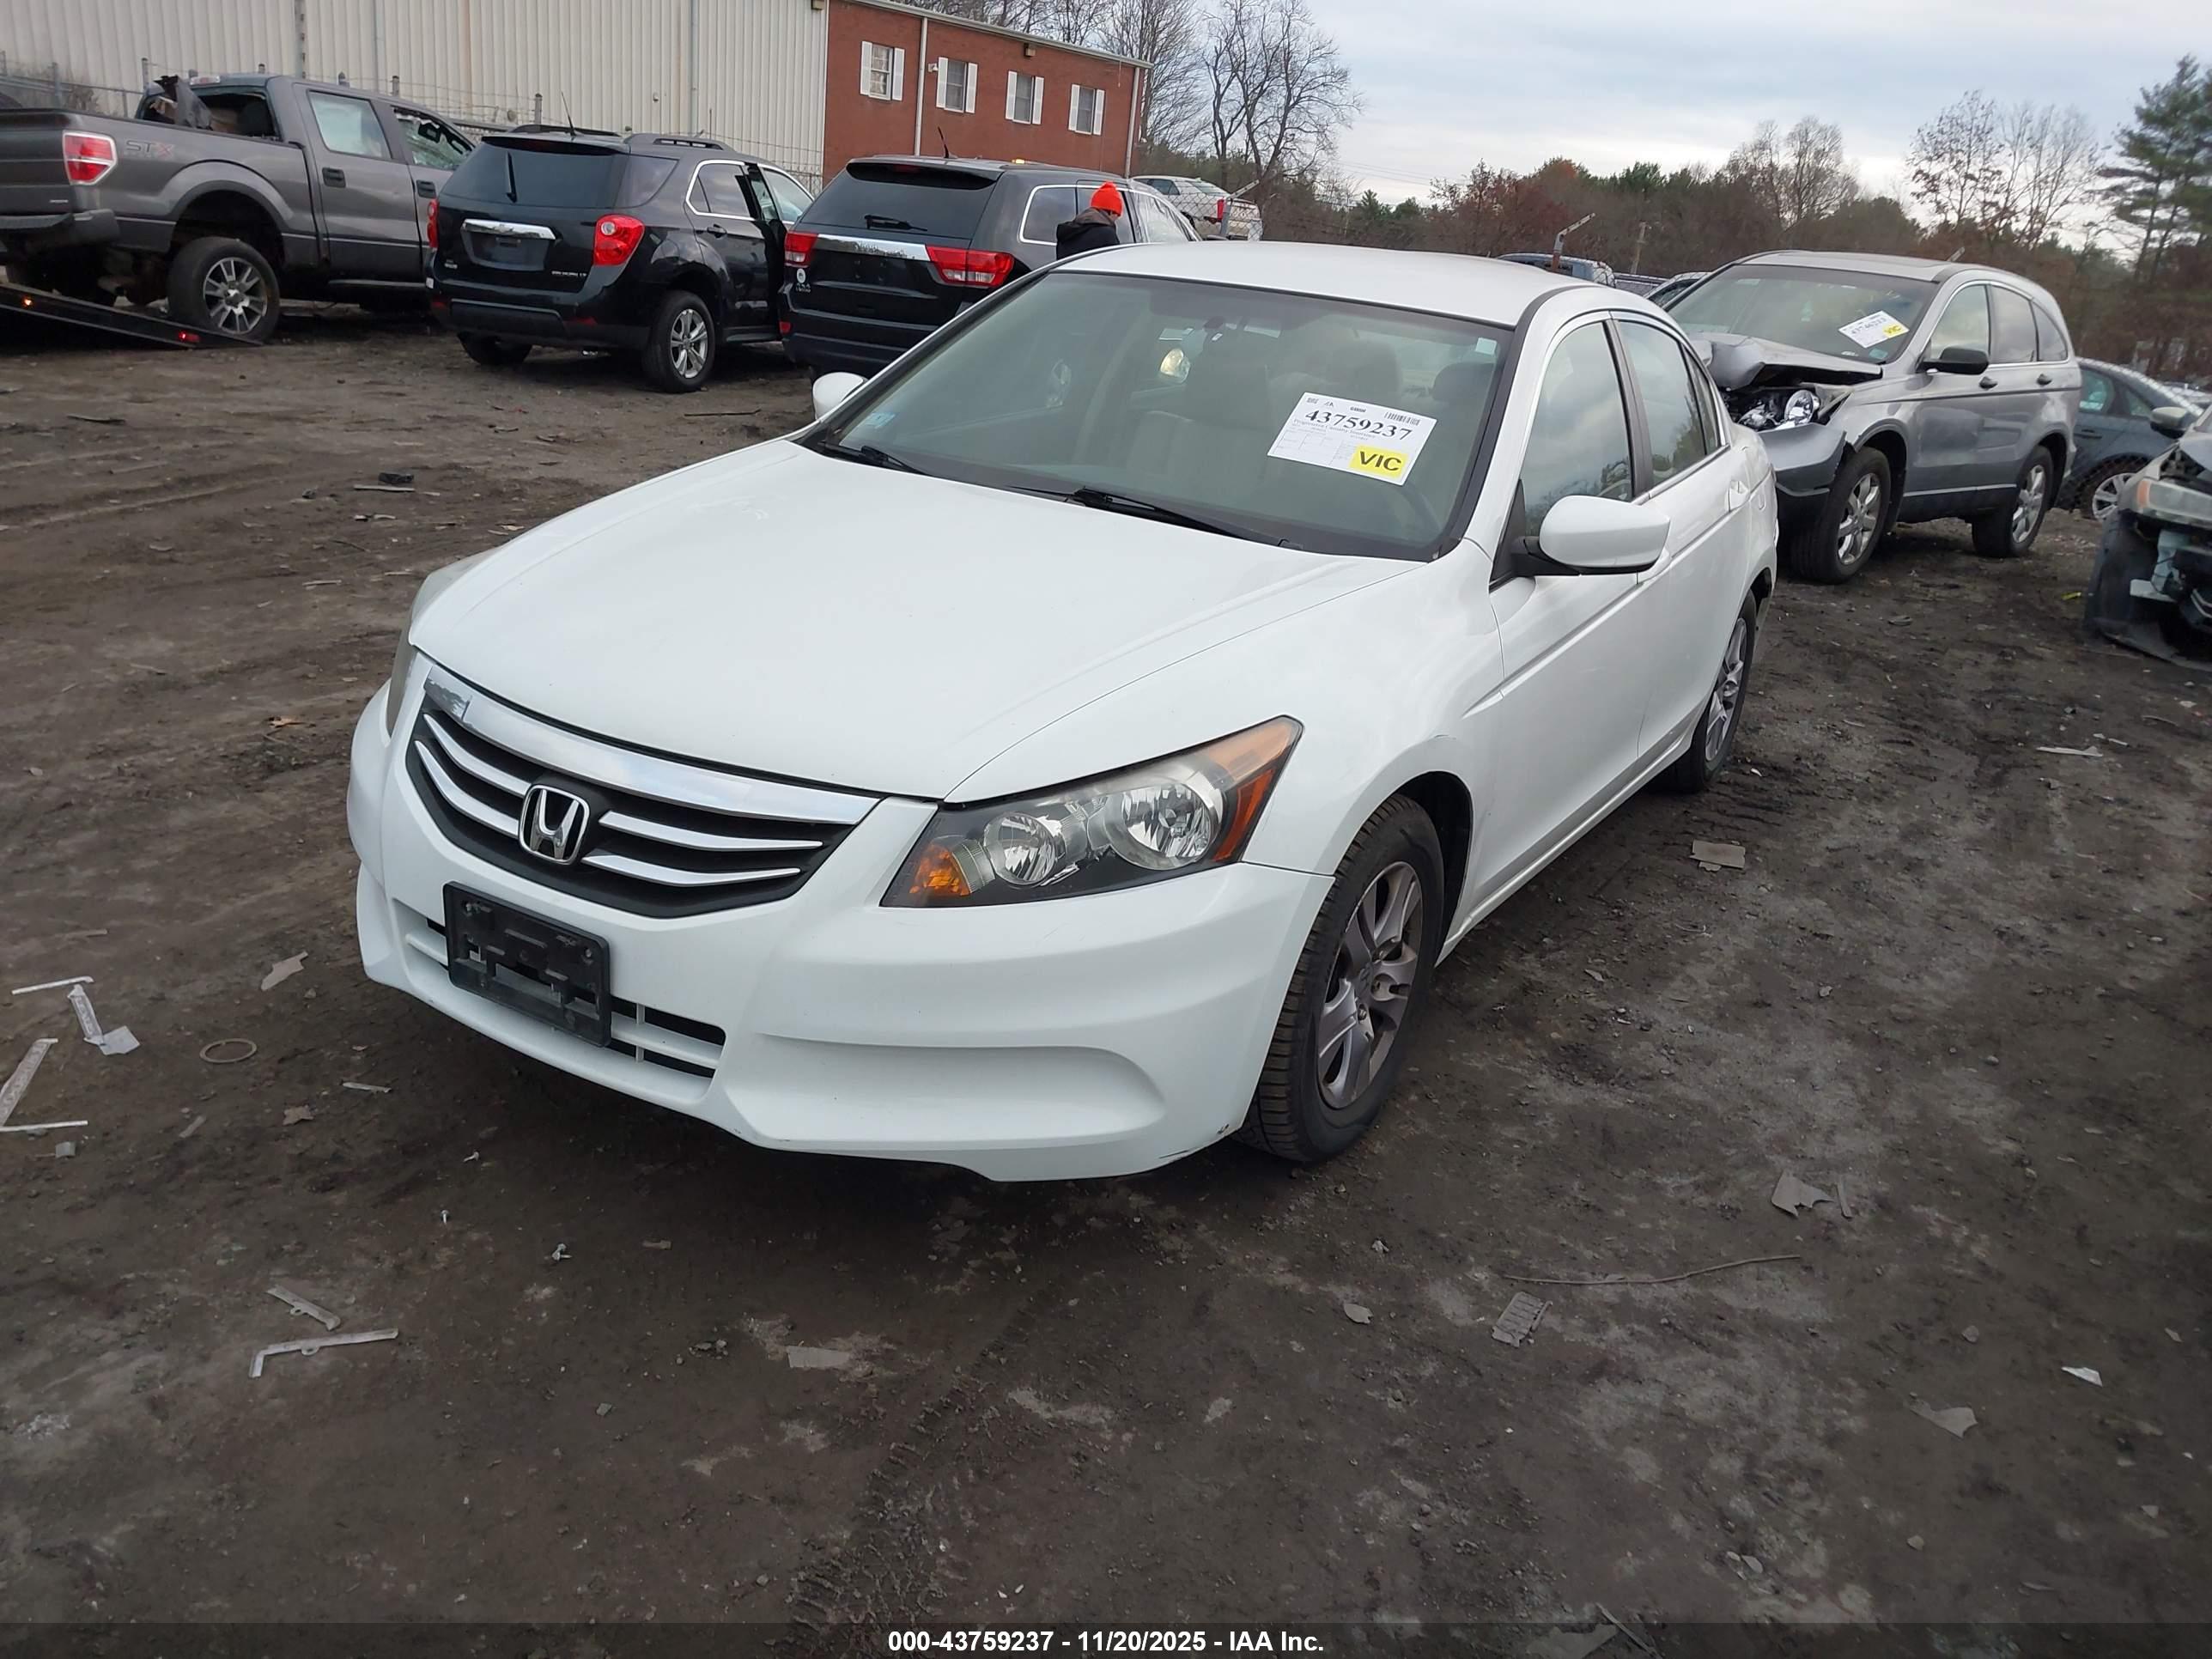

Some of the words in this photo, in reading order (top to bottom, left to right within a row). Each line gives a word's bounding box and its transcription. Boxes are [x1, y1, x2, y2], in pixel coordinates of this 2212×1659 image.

[126, 139, 172, 156] STX
[1305, 410, 1413, 440] 43759237
[1358, 450, 1403, 471] VIC
